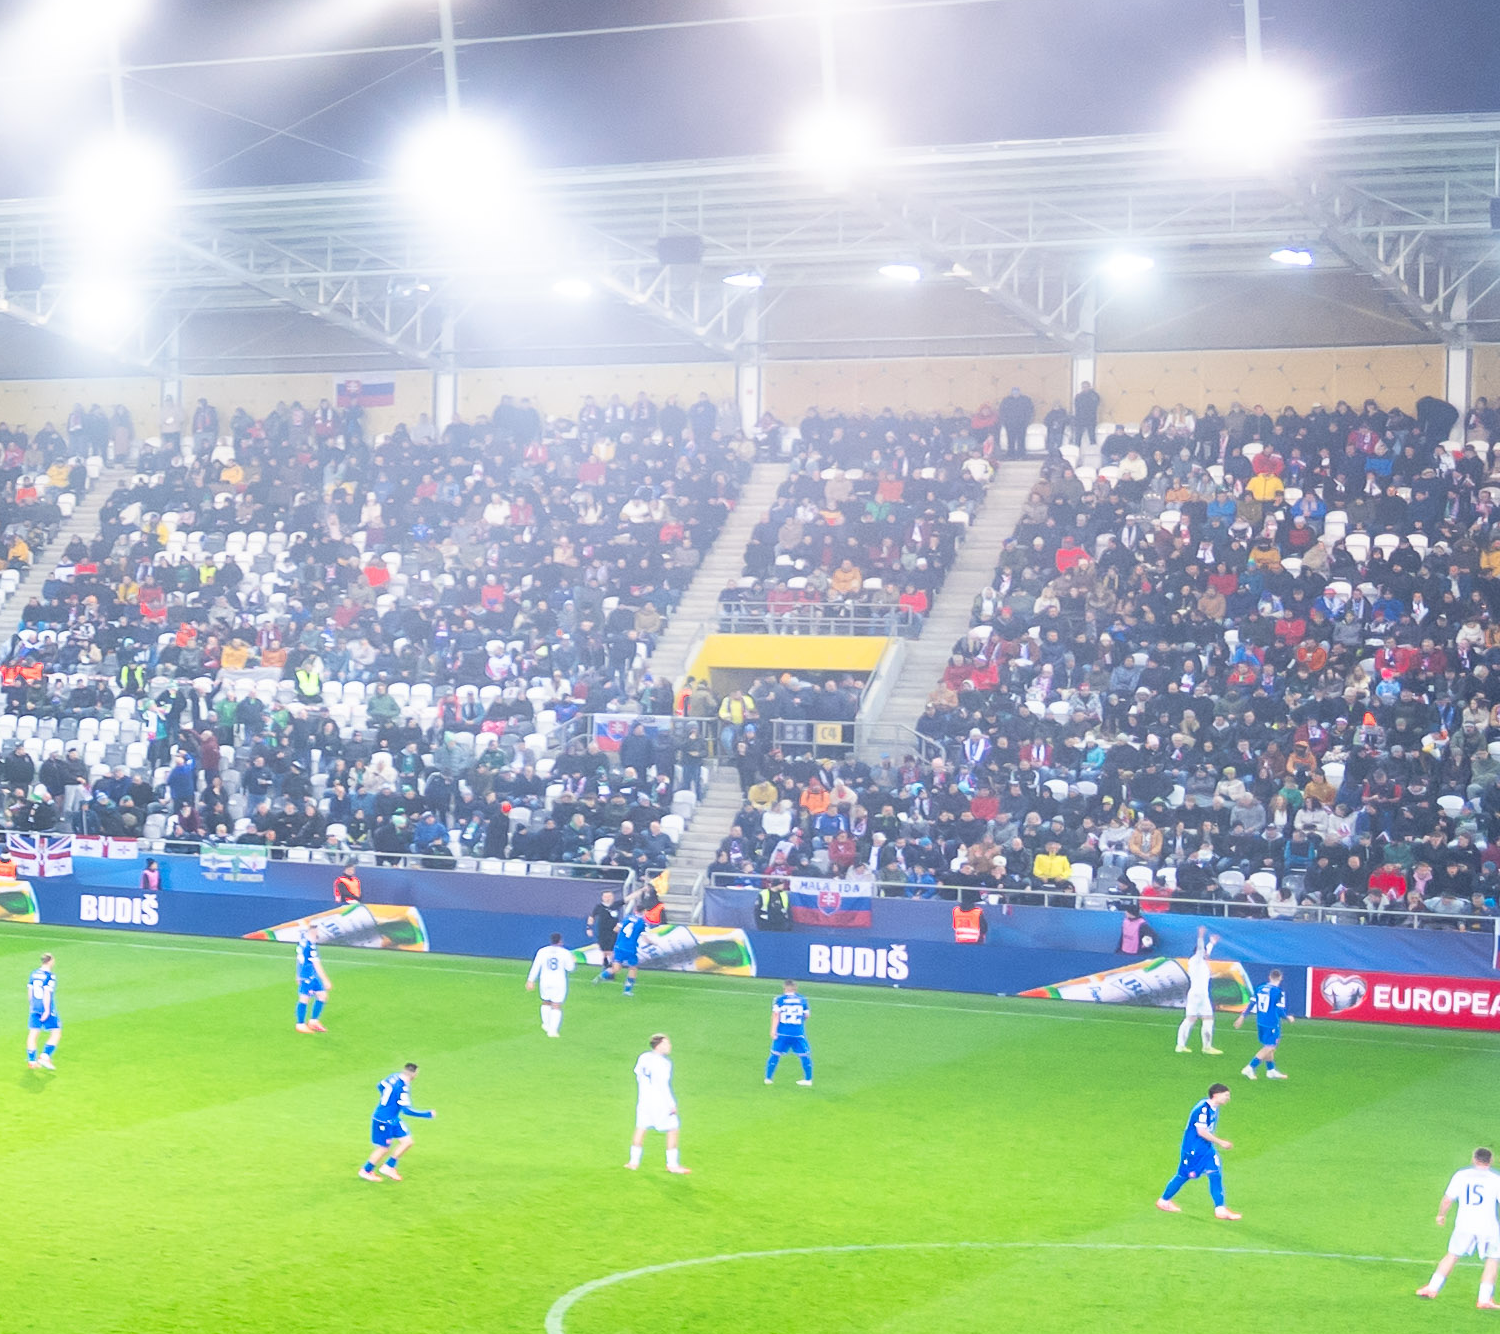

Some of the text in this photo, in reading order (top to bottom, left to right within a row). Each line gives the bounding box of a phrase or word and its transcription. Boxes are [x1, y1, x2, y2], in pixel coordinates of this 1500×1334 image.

[80, 894, 159, 926] BUDIŠ
[809, 944, 909, 980] BUDIŠ
[780, 1005, 803, 1025] 22
[1466, 1183, 1484, 1205] 15
